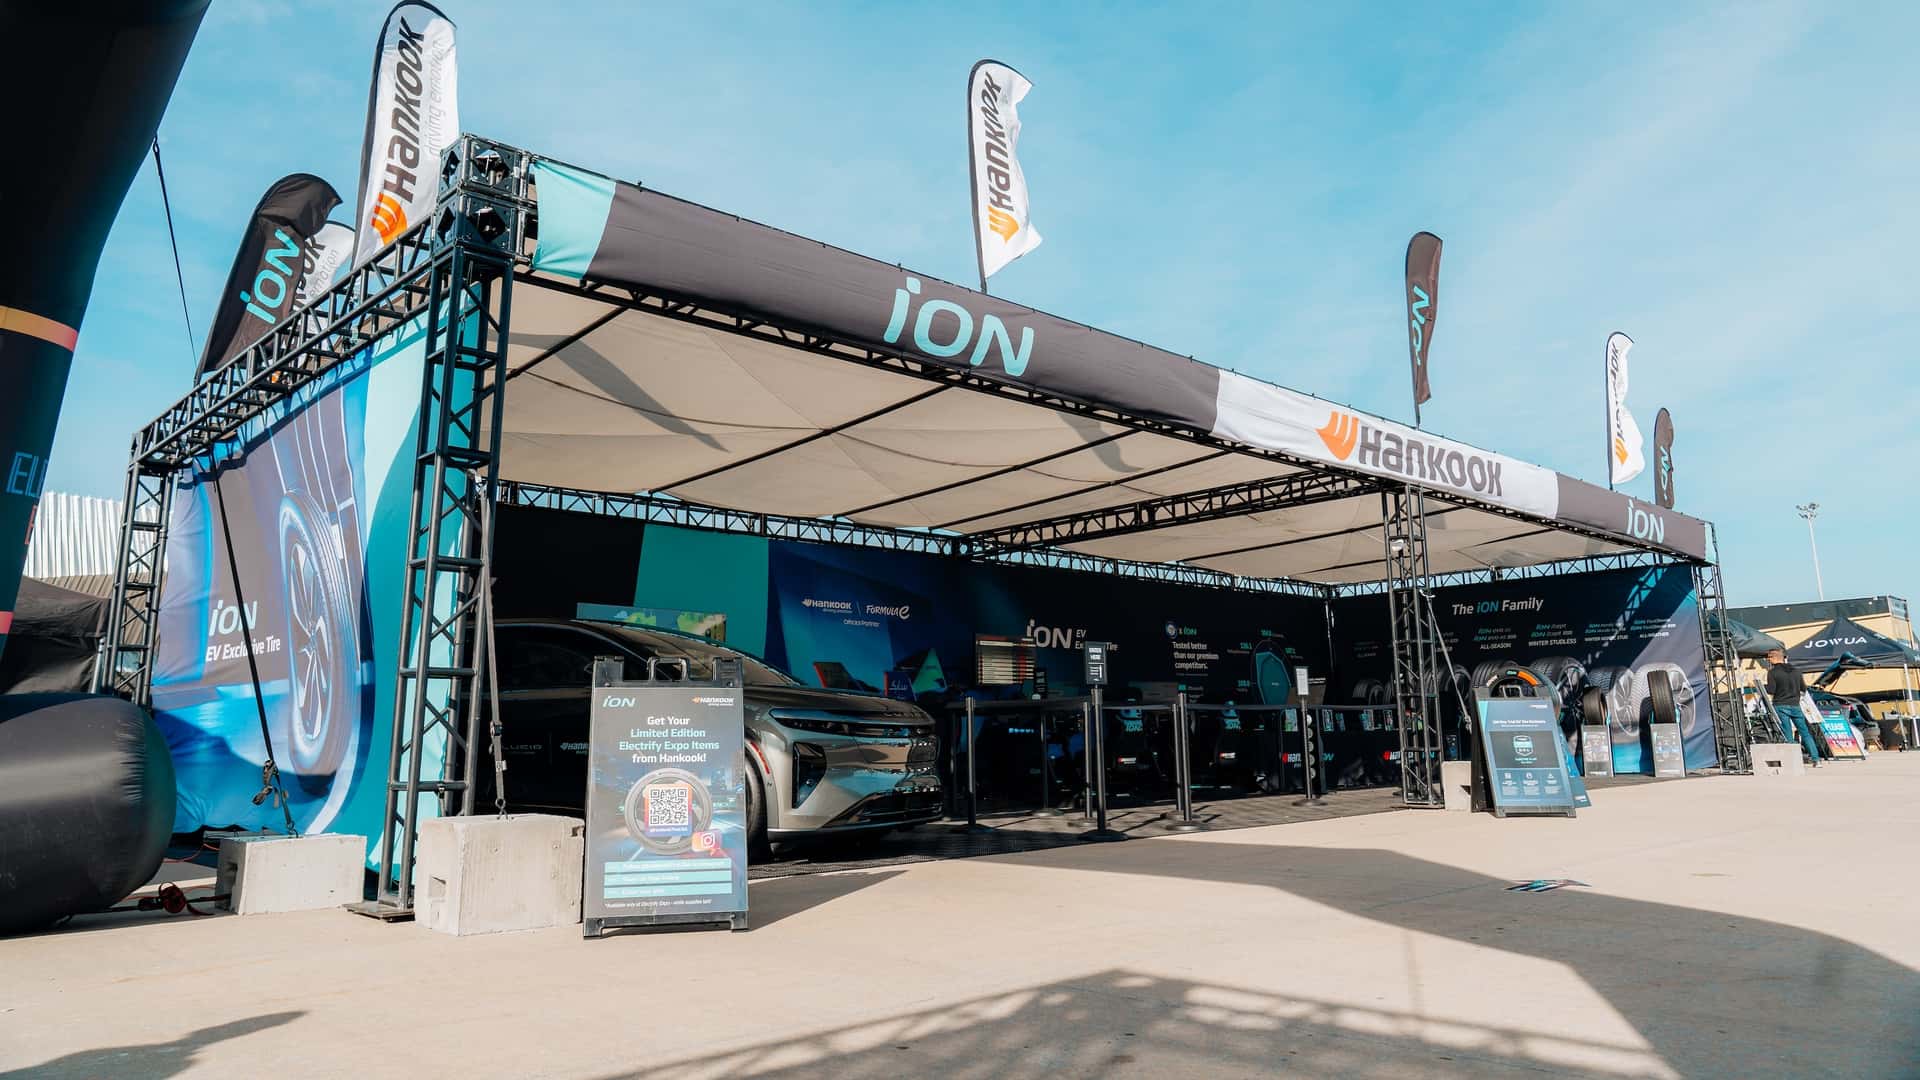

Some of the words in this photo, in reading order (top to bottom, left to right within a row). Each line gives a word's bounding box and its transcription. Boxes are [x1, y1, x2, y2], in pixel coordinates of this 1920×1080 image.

[240, 228, 300, 324] iON
[883, 277, 1035, 377] iON
[1627, 500, 1664, 543] iON
[1452, 604, 1474, 615] The
[1476, 600, 1499, 613] iON
[1502, 597, 1544, 611] Family
[208, 600, 257, 637] iON
[1026, 618, 1073, 649] iON
[1076, 629, 1087, 638] EV
[1804, 636, 1868, 649] JOWUA
[205, 644, 222, 662] EV
[222, 638, 264, 660] Excluive
[266, 635, 280, 653] Tire
[602, 695, 636, 708] iON
[647, 716, 665, 725] Get
[667, 716, 691, 726] Your
[630, 728, 669, 738] Limited
[671, 727, 706, 738] Edition
[618, 741, 662, 753] Electrify
[664, 740, 690, 752] Expo
[691, 740, 720, 750] Items
[632, 753, 657, 763] from
[659, 752, 707, 763] Hankook!
